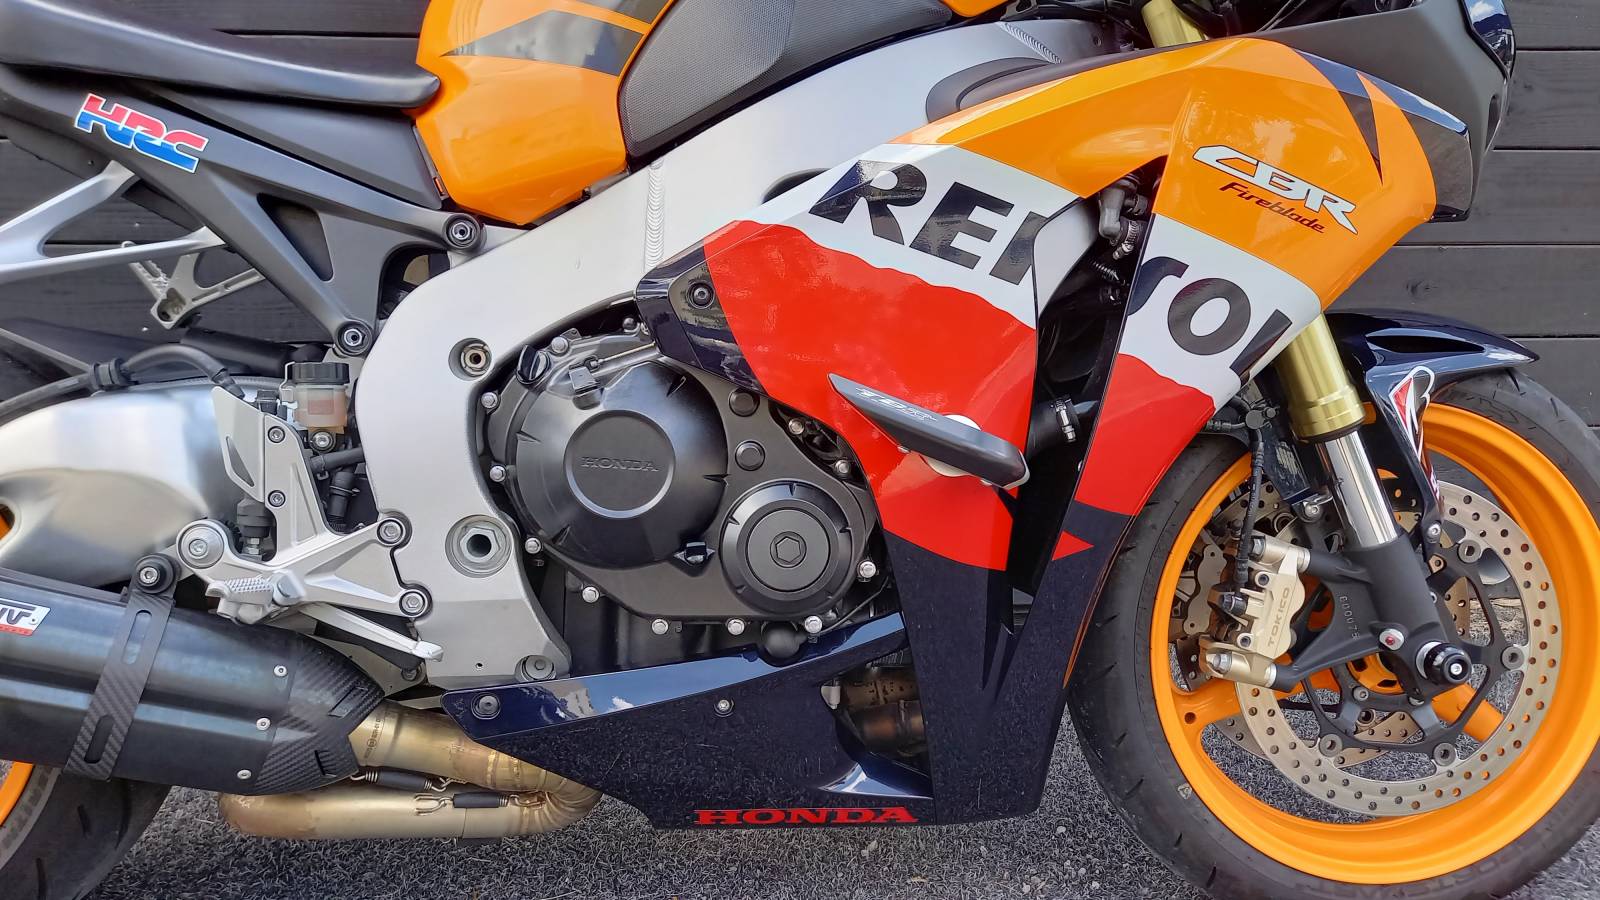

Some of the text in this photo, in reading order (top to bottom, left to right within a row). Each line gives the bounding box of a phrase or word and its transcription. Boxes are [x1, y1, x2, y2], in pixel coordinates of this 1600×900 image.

[74, 93, 209, 174] HRC
[1192, 144, 1359, 235] CBR
[1219, 181, 1326, 234] Fireblade
[579, 455, 661, 472] HONDA
[1267, 587, 1290, 647] TOKICO
[694, 806, 919, 825] HONDA
